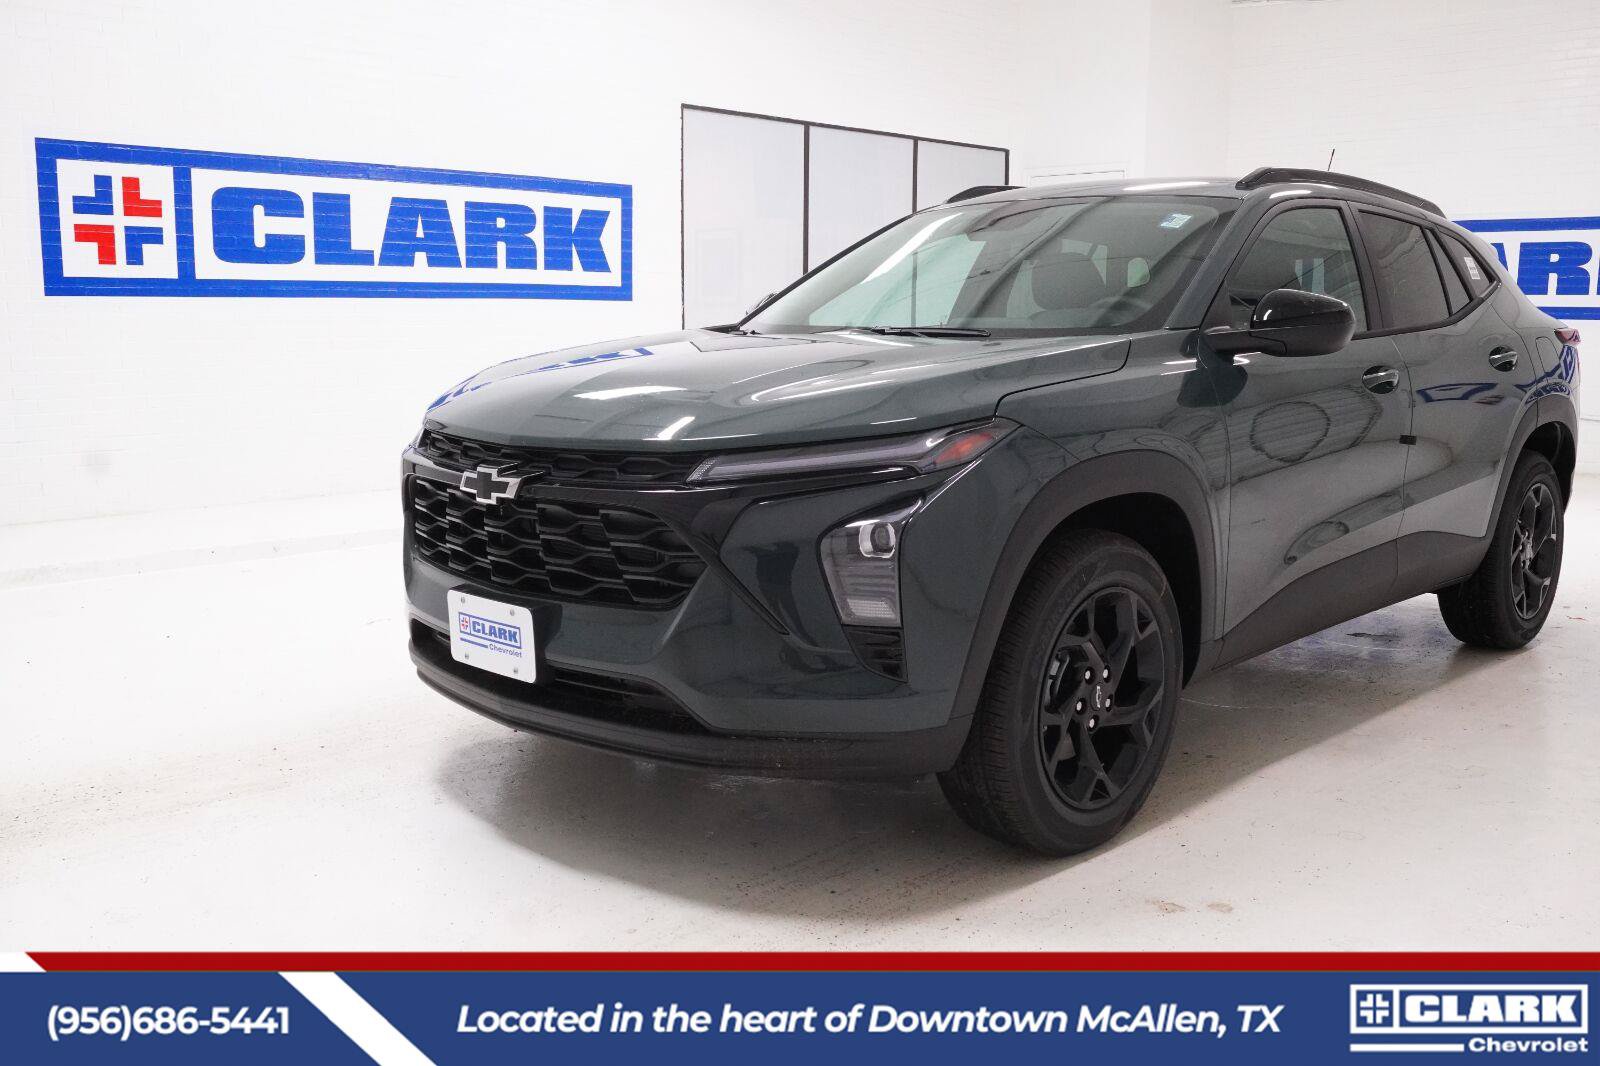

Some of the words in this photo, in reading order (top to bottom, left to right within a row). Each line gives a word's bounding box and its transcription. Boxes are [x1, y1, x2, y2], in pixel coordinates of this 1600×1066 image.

[212, 187, 610, 272] CLARK
[472, 620, 518, 643] CLARK
[489, 643, 522, 658] Chevrolet
